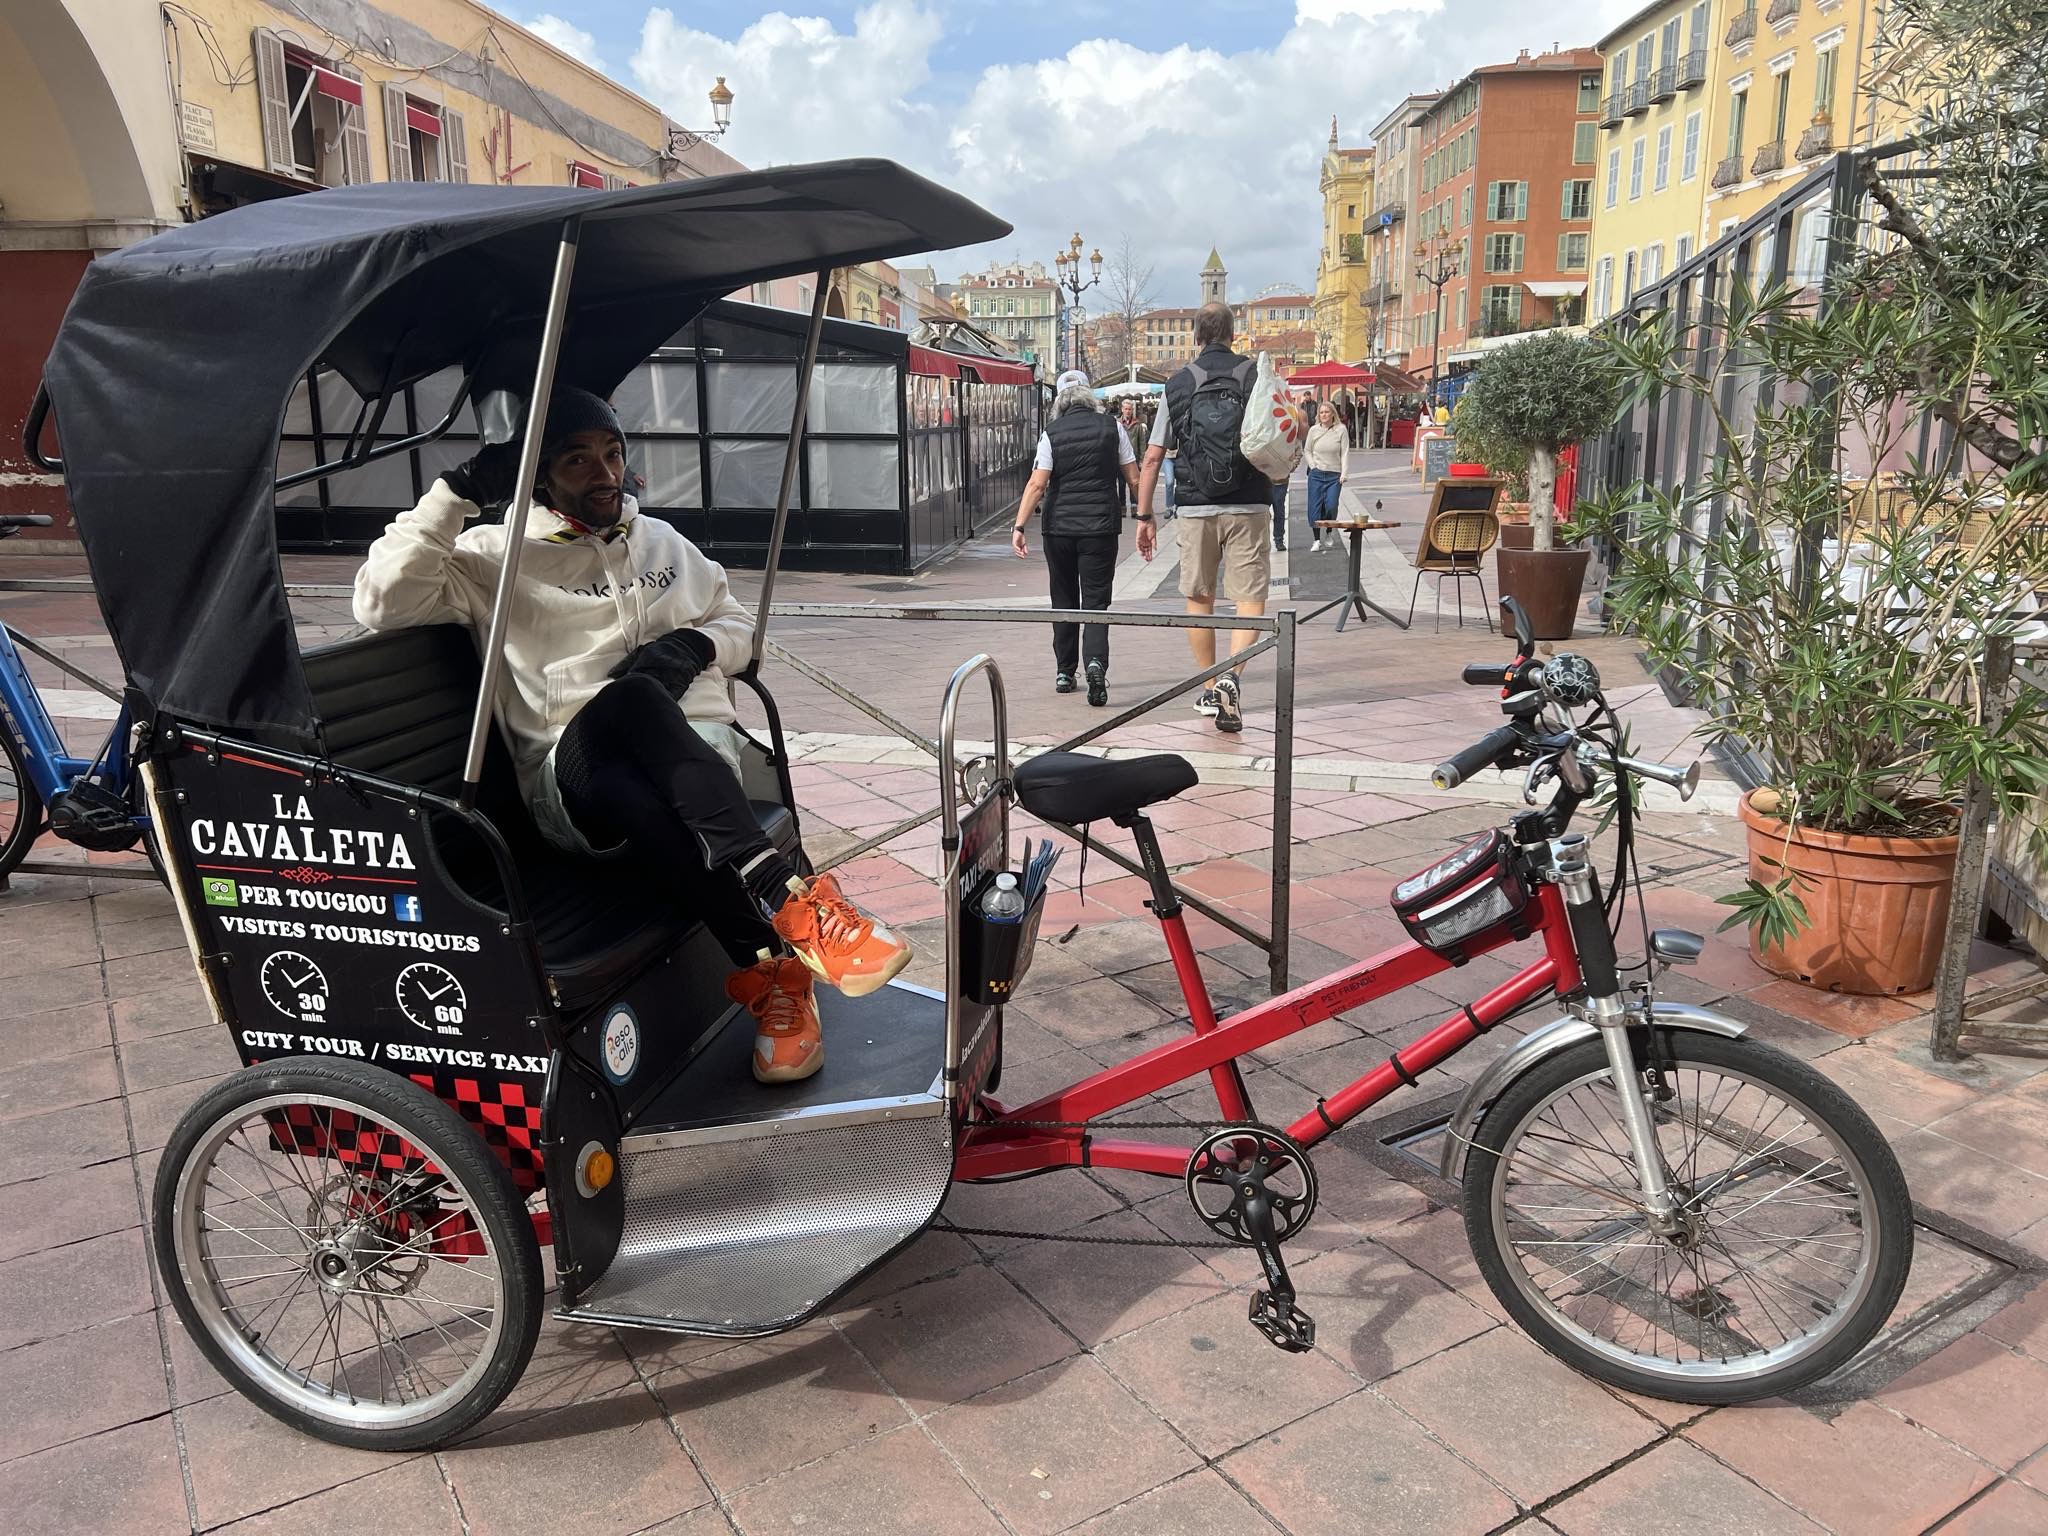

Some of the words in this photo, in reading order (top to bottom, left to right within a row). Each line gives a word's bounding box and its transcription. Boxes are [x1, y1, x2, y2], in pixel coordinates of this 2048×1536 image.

[272, 794, 314, 821] LA
[190, 819, 416, 870] CAVALETA
[960, 863, 977, 901] TAXI
[239, 885, 283, 907] PER
[286, 889, 387, 915] TOUGIOU
[219, 916, 306, 938] VISITES
[310, 924, 481, 952] TOURISTIQUES
[298, 993, 326, 1011] 30
[434, 1005, 464, 1024] 60
[301, 1012, 327, 1023] min.
[437, 1025, 463, 1036] min.
[242, 1030, 294, 1050] CITY
[299, 1035, 366, 1057] TOUR
[370, 1042, 380, 1060] /
[386, 1043, 487, 1068] SERVICE
[490, 1052, 549, 1074] TAXI
